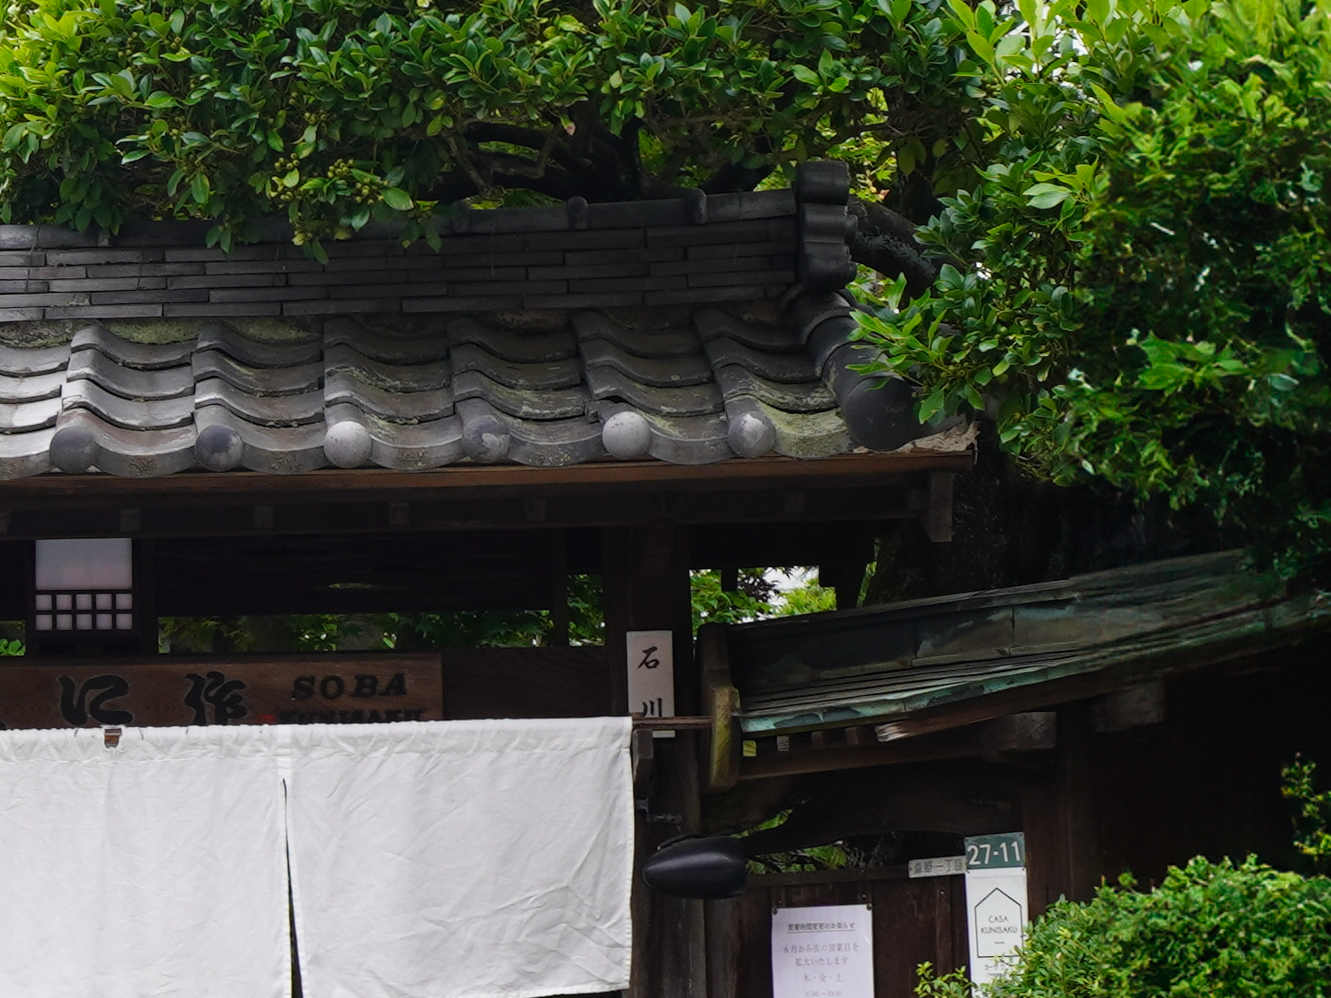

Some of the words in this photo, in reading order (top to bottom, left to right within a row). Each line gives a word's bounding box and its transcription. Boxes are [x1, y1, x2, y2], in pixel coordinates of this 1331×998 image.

[290, 671, 408, 700] SOBA
[637, 645, 663, 718] 石川
[968, 840, 1021, 865] 27-11
[980, 926, 1018, 934] KUNISAKU
[988, 915, 1009, 923] CASA
